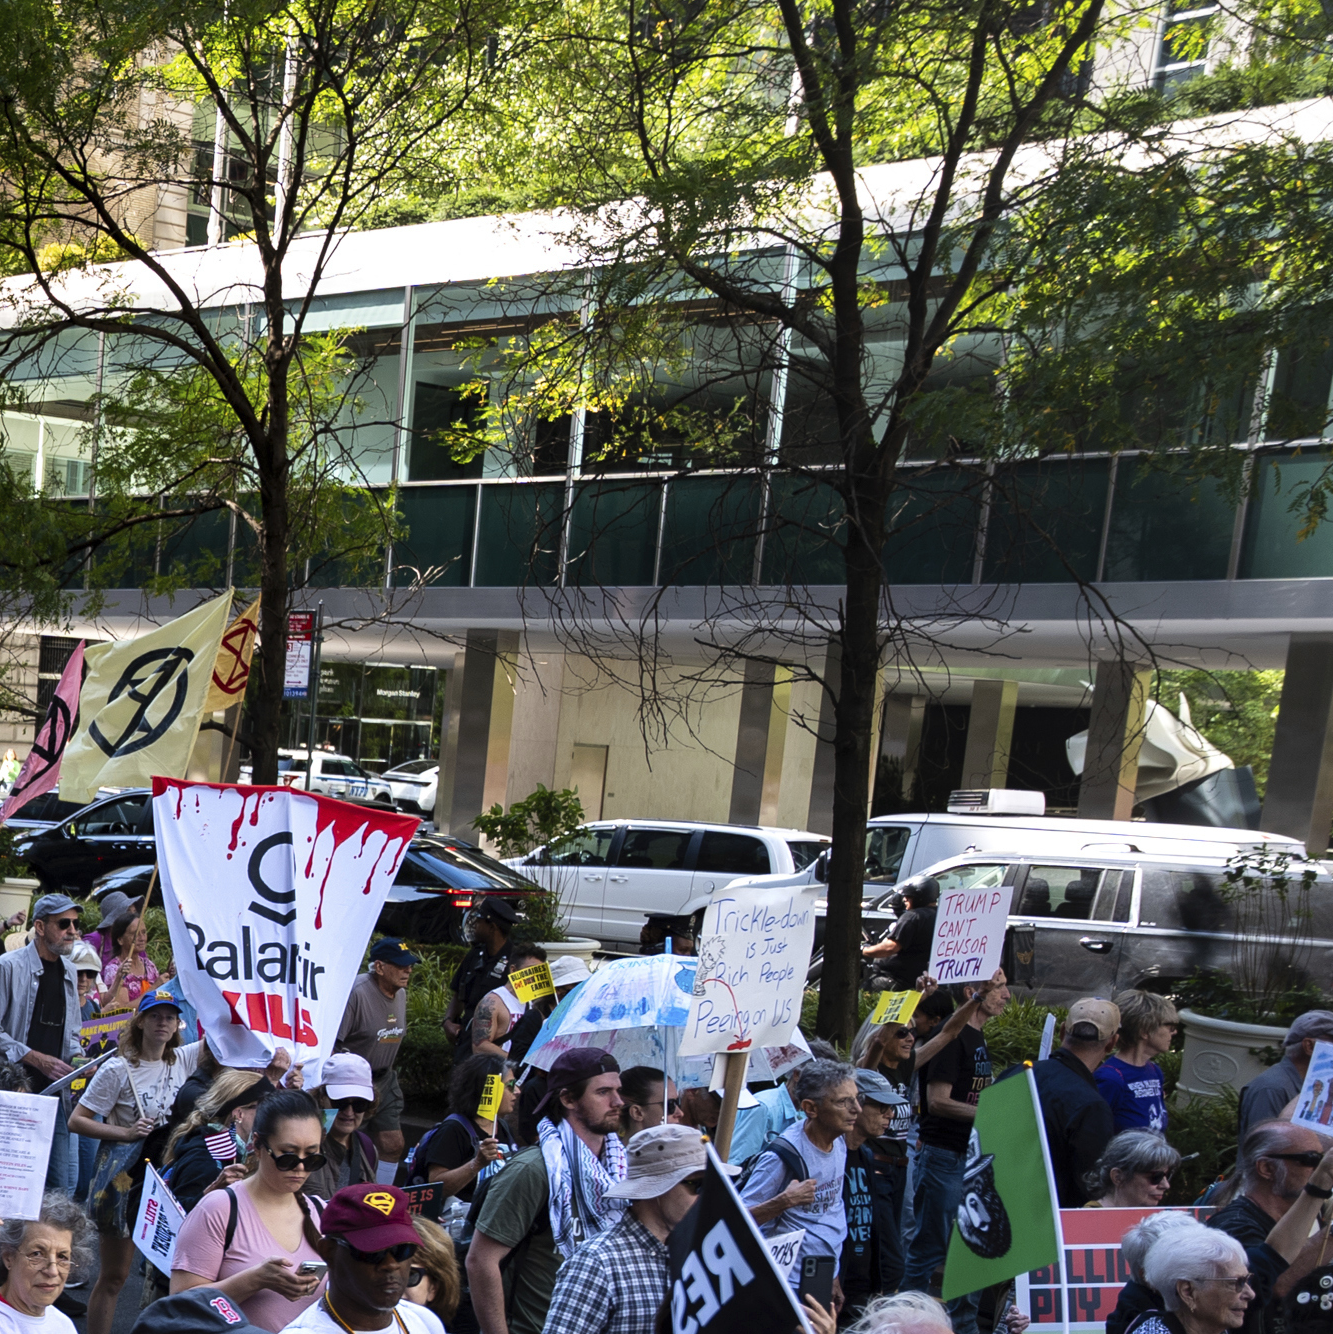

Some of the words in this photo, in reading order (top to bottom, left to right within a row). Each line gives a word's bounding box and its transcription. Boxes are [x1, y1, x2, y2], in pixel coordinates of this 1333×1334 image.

[377, 689, 398, 697] Morgan
[398, 690, 420, 699] Stanley
[349, 786, 368, 797] NYPD
[945, 892, 1001, 916] TRUMP
[938, 918, 976, 938] CAN'T
[746, 941, 756, 958] is
[761, 937, 788, 956] Just
[936, 936, 988, 957] CENSOR
[510, 964, 546, 982] BILLIONAIRES
[537, 973, 548, 982] THE
[714, 962, 748, 988] Rich
[759, 962, 794, 990] People
[935, 957, 983, 980] TRUTH
[531, 981, 550, 992] EARTH
[753, 1009, 766, 1025] on
